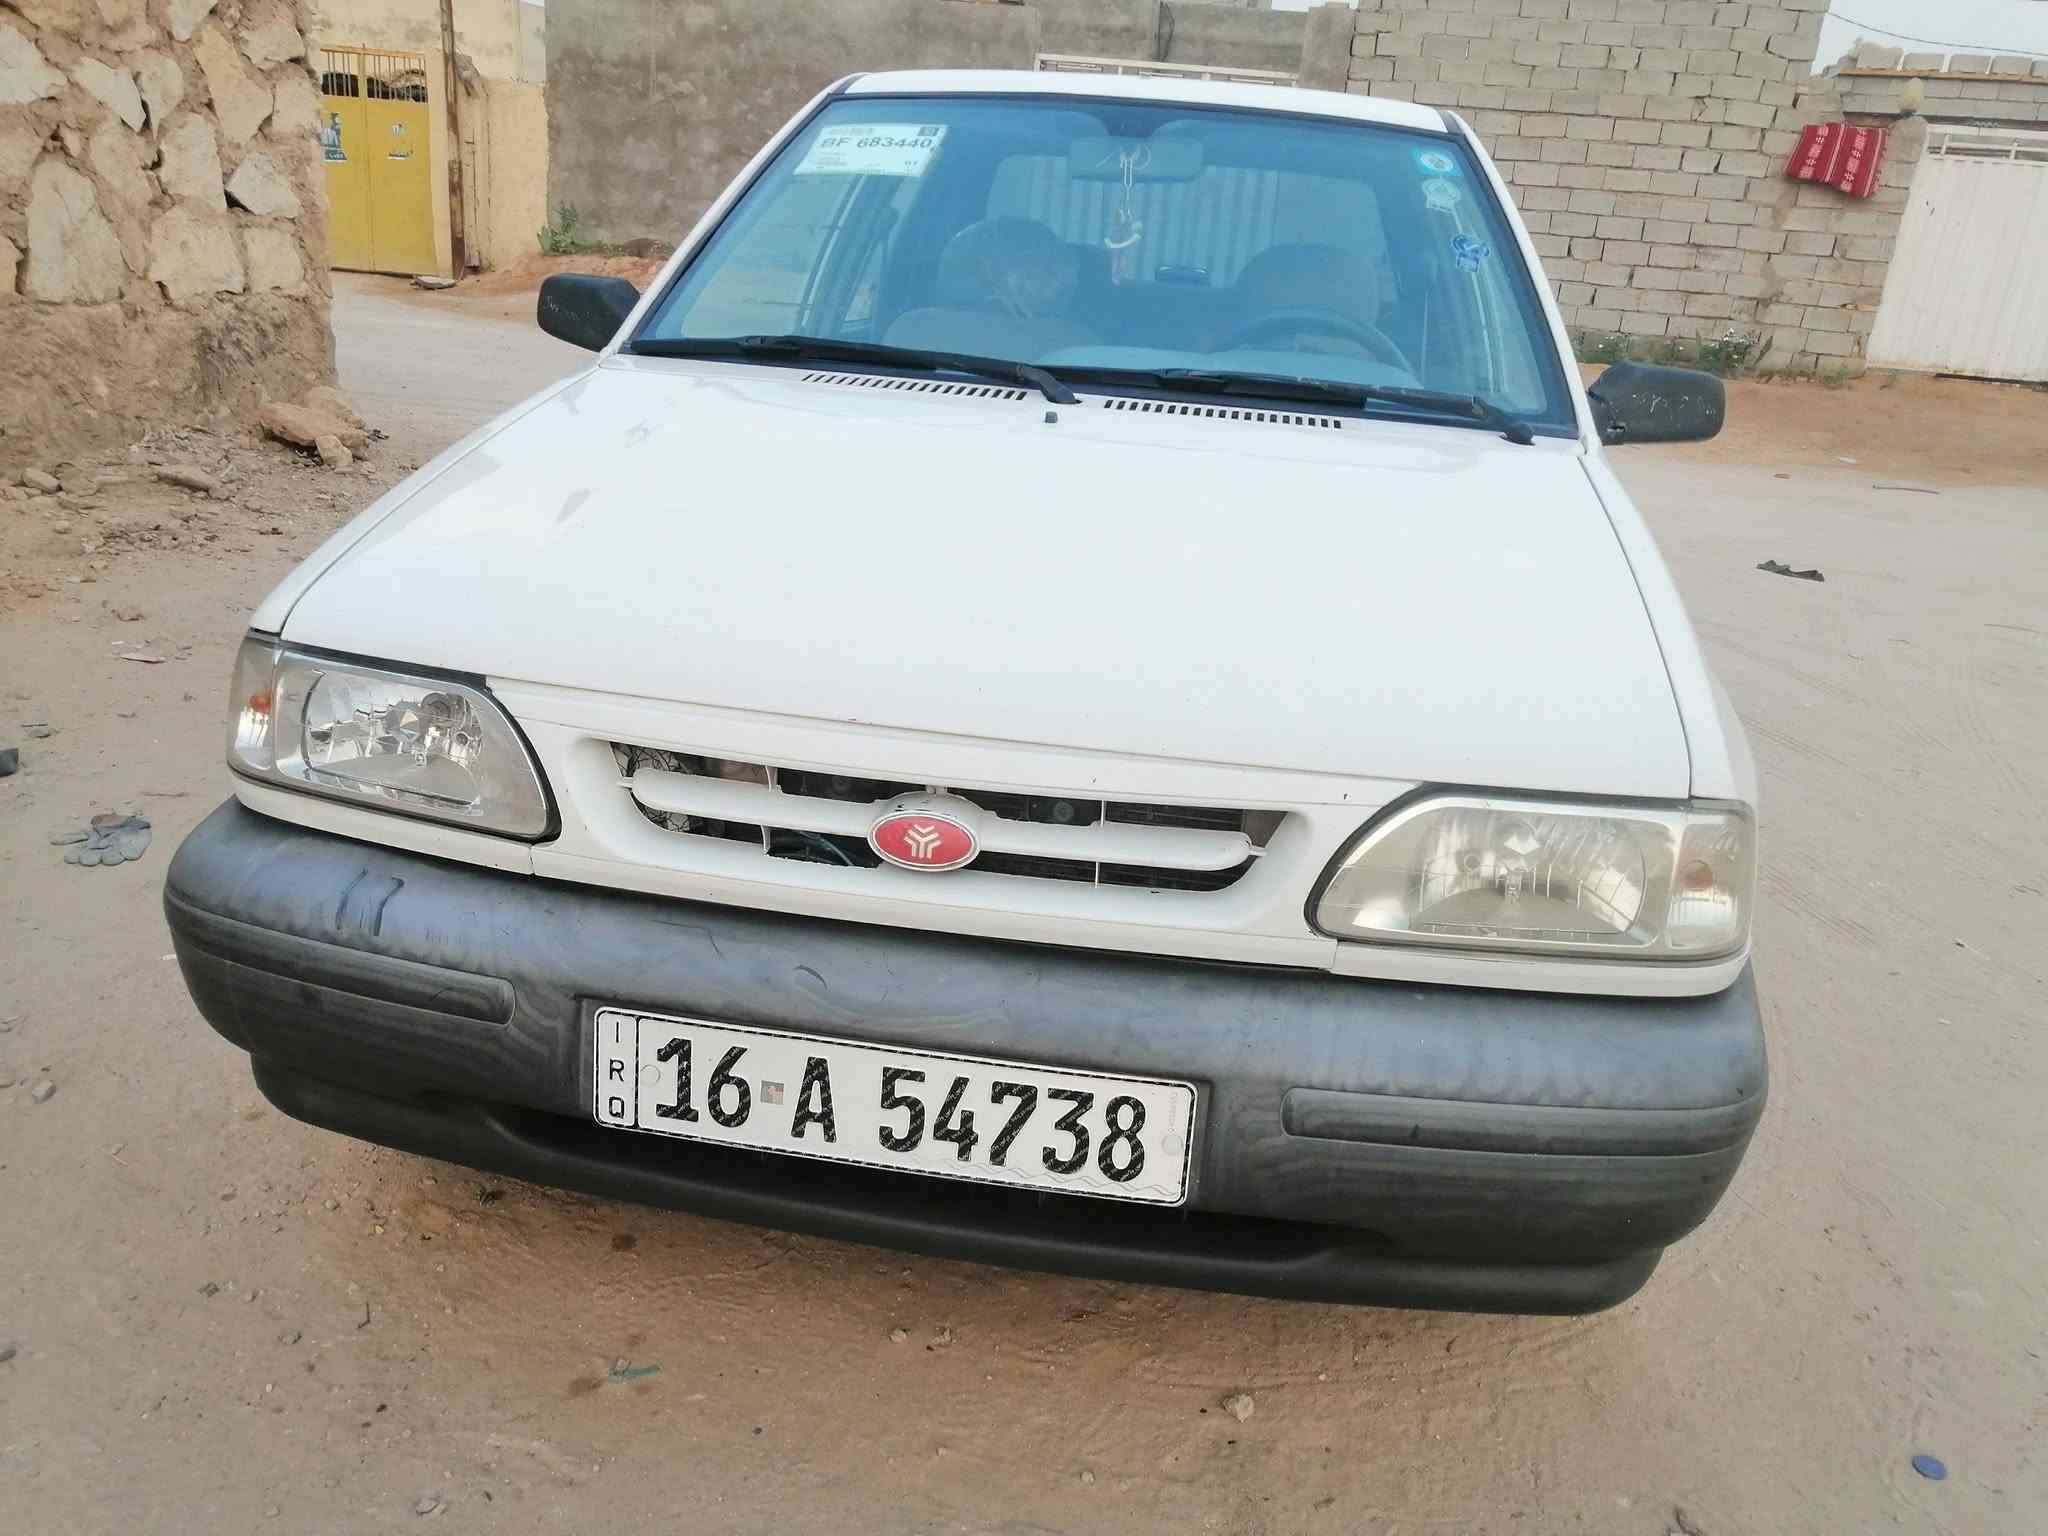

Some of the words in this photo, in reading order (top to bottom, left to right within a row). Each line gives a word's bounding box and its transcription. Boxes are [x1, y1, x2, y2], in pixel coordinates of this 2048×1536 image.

[856, 136, 934, 149] 683440
[655, 1037, 752, 1128] 16
[790, 1056, 838, 1143] A
[878, 1066, 1147, 1183] 54738
